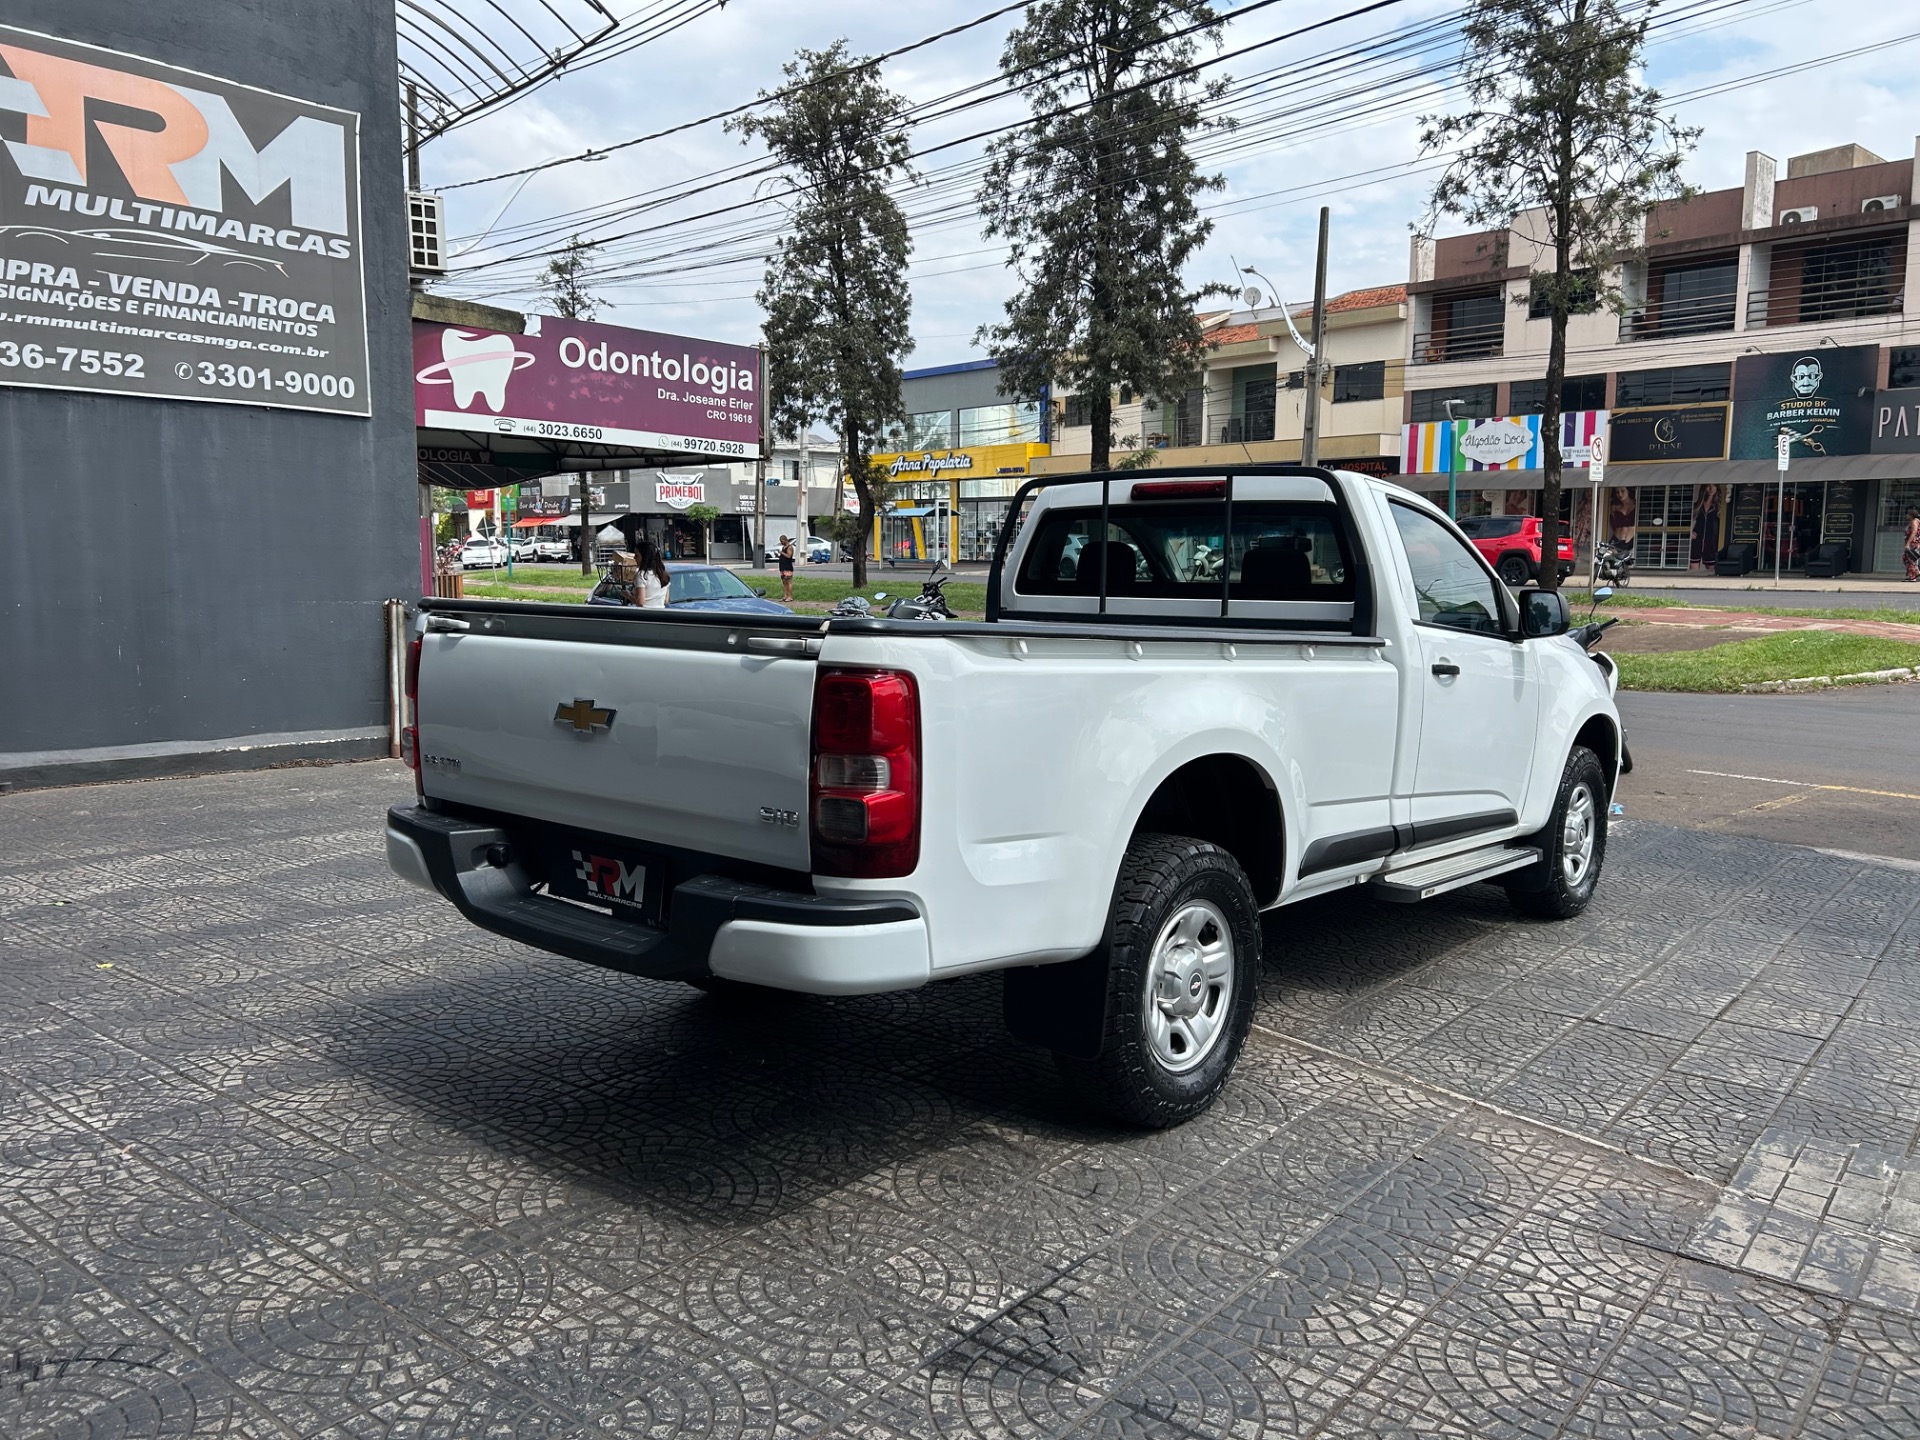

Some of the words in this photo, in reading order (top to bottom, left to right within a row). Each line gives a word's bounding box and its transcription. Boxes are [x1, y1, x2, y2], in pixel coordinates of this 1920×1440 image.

[25, 184, 351, 259] MULTIMARCAS
[0, 257, 80, 289] PRA
[108, 273, 221, 308] VENDA
[126, 300, 138, 315] E
[143, 301, 318, 337] FINANCIAMENTOS
[0, 341, 145, 379] 36-7552
[197, 361, 355, 399] 3301-9000
[558, 336, 753, 394] Odontologia
[657, 388, 680, 402] Dra.
[682, 391, 727, 408] Joseane
[729, 398, 753, 410] Erler
[1780, 400, 1813, 410] STUDIO
[1814, 400, 1827, 408] BK
[706, 410, 727, 421] CRO
[729, 412, 753, 424] 19618
[1766, 408, 1805, 421] BARBER
[1806, 408, 1841, 417] KELVIN
[523, 424, 536, 433] (44)
[538, 423, 603, 440] 3023.6650
[671, 440, 682, 448] (44)
[684, 438, 745, 454] 99720.5928
[1465, 434, 1501, 448] Algodão
[1504, 433, 1527, 445] Doce
[418, 449, 473, 462] OLOGIA
[890, 455, 921, 476] Anna
[922, 452, 972, 477] Papelaria
[1340, 461, 1388, 472] HOSPITAL
[659, 485, 702, 501] PRIMEBOI
[590, 854, 646, 903] RM
[587, 890, 643, 909] MULTIMARCAS
